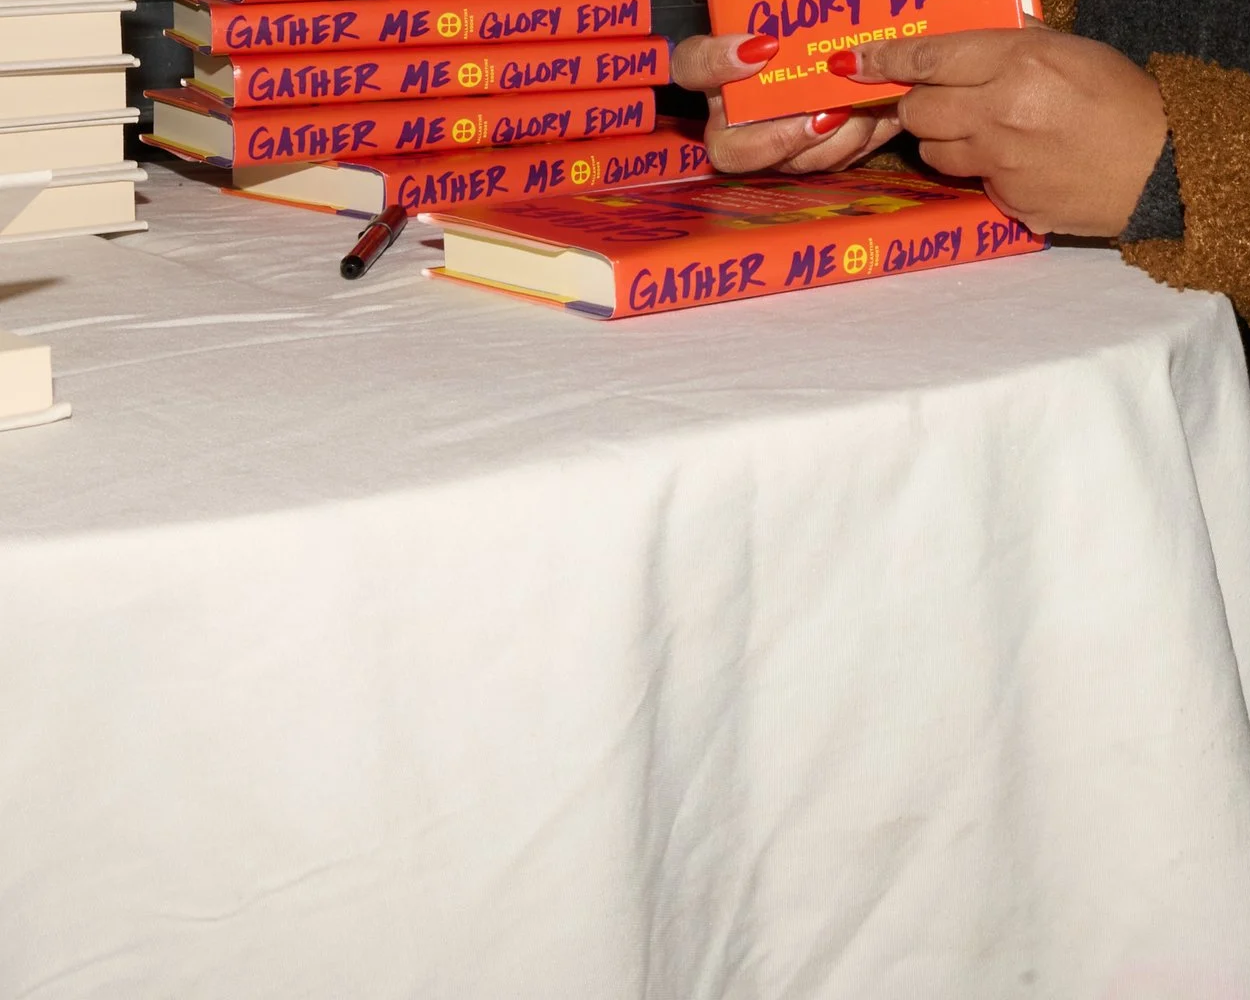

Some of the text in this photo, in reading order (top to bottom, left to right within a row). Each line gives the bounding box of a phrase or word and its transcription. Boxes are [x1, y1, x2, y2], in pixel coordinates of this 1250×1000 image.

[226, 0, 638, 49] GATHER ME GLORY EDIM
[806, 20, 928, 57] FOUNDER OF
[248, 50, 657, 101] GATHER ME GLORY EDIM
[758, 61, 829, 86] WELL-R
[248, 102, 644, 159] GATHER ME GLORY EDIM
[398, 144, 711, 209] GATHER ME GLORY ED
[630, 253, 767, 309] GATHER
[785, 245, 837, 286] ME
[883, 227, 962, 272] GLORY
